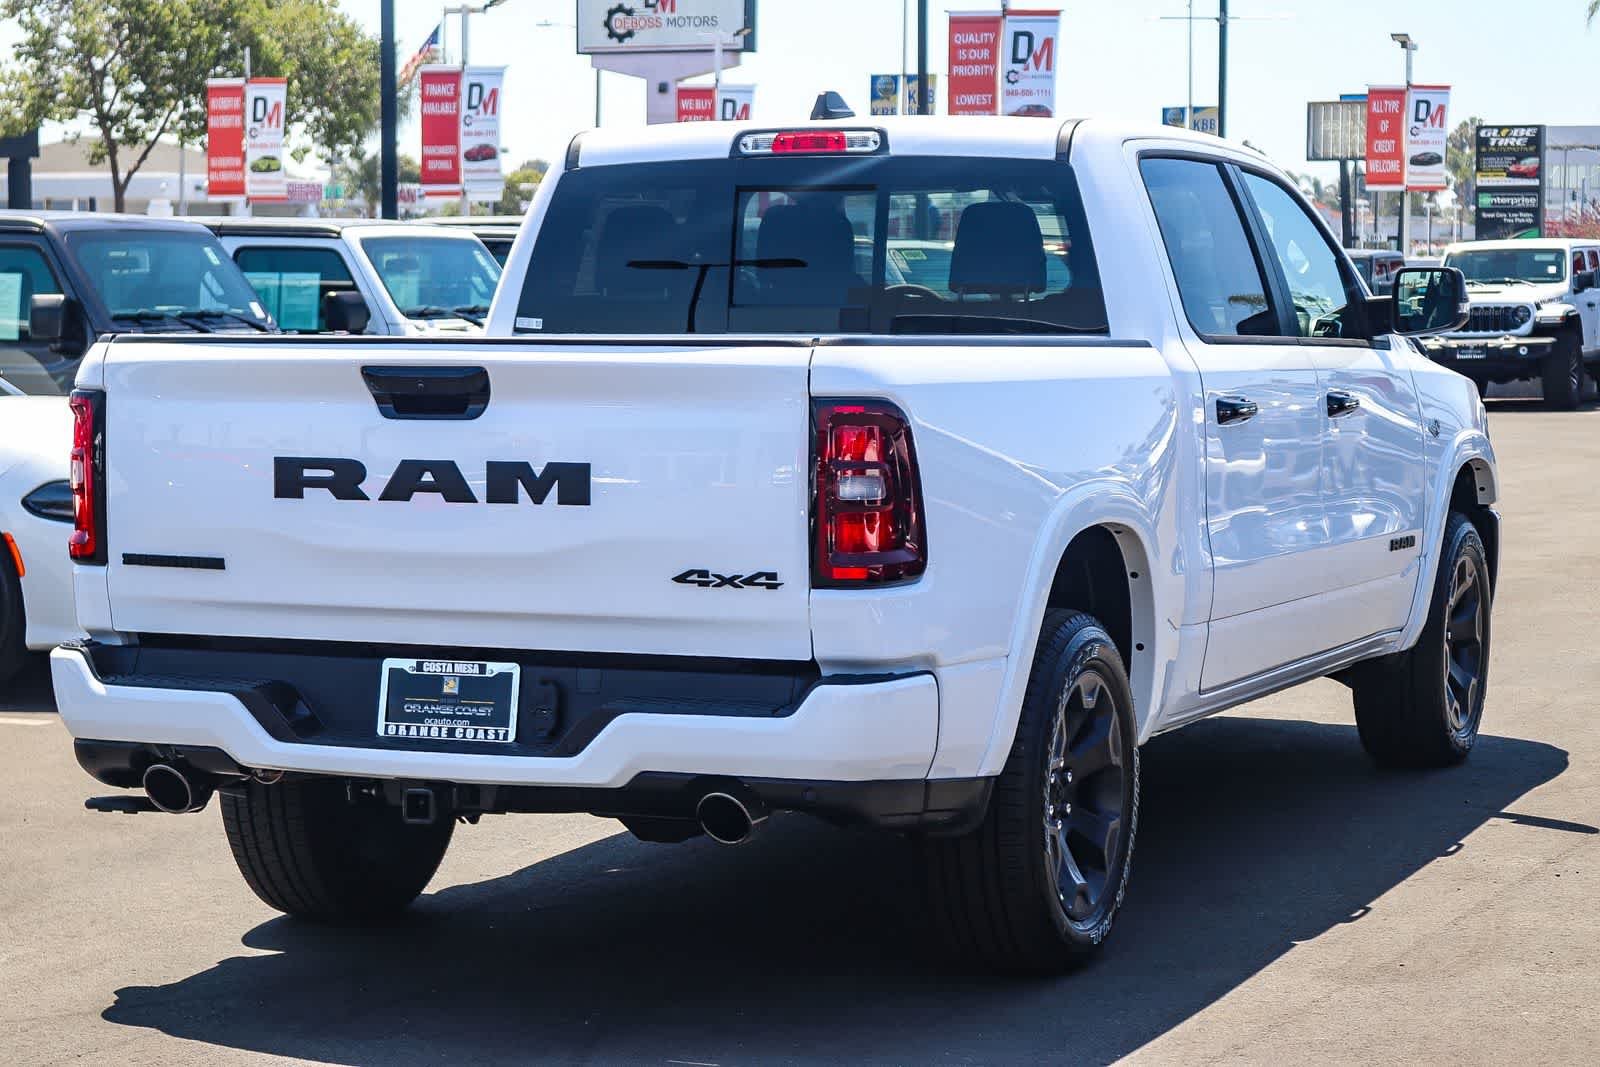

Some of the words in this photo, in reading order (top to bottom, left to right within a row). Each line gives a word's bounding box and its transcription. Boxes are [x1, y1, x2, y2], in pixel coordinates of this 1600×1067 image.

[614, 17, 662, 29] DEBOSS
[666, 16, 719, 28] MOTORS
[955, 32, 995, 45] QUALITY
[959, 50, 968, 60] IS
[970, 50, 990, 60] OUR
[953, 65, 996, 77] PRIORITY
[425, 84, 456, 96] FINANCE
[681, 99, 694, 110] WE
[695, 98, 713, 110] BUY
[955, 94, 993, 106] LOWEST
[422, 102, 457, 114] AVAILABLE
[1372, 101, 1384, 113] ALL
[1385, 101, 1400, 113] TYPE
[1193, 118, 1217, 130] KBB
[1380, 120, 1390, 133] OF
[1374, 140, 1396, 153] CREDIT
[1489, 138, 1529, 147] TIRE
[1369, 160, 1401, 173] WELCOME
[273, 456, 592, 506] RAM
[671, 568, 785, 590] 4x4
[422, 662, 453, 673] COSTA
[454, 663, 480, 674] MESA
[403, 704, 454, 715] ORANGE
[455, 705, 494, 717] COAST
[424, 718, 470, 727] ocauto.com
[387, 725, 449, 738] ORANGE
[455, 728, 506, 741] COAST
